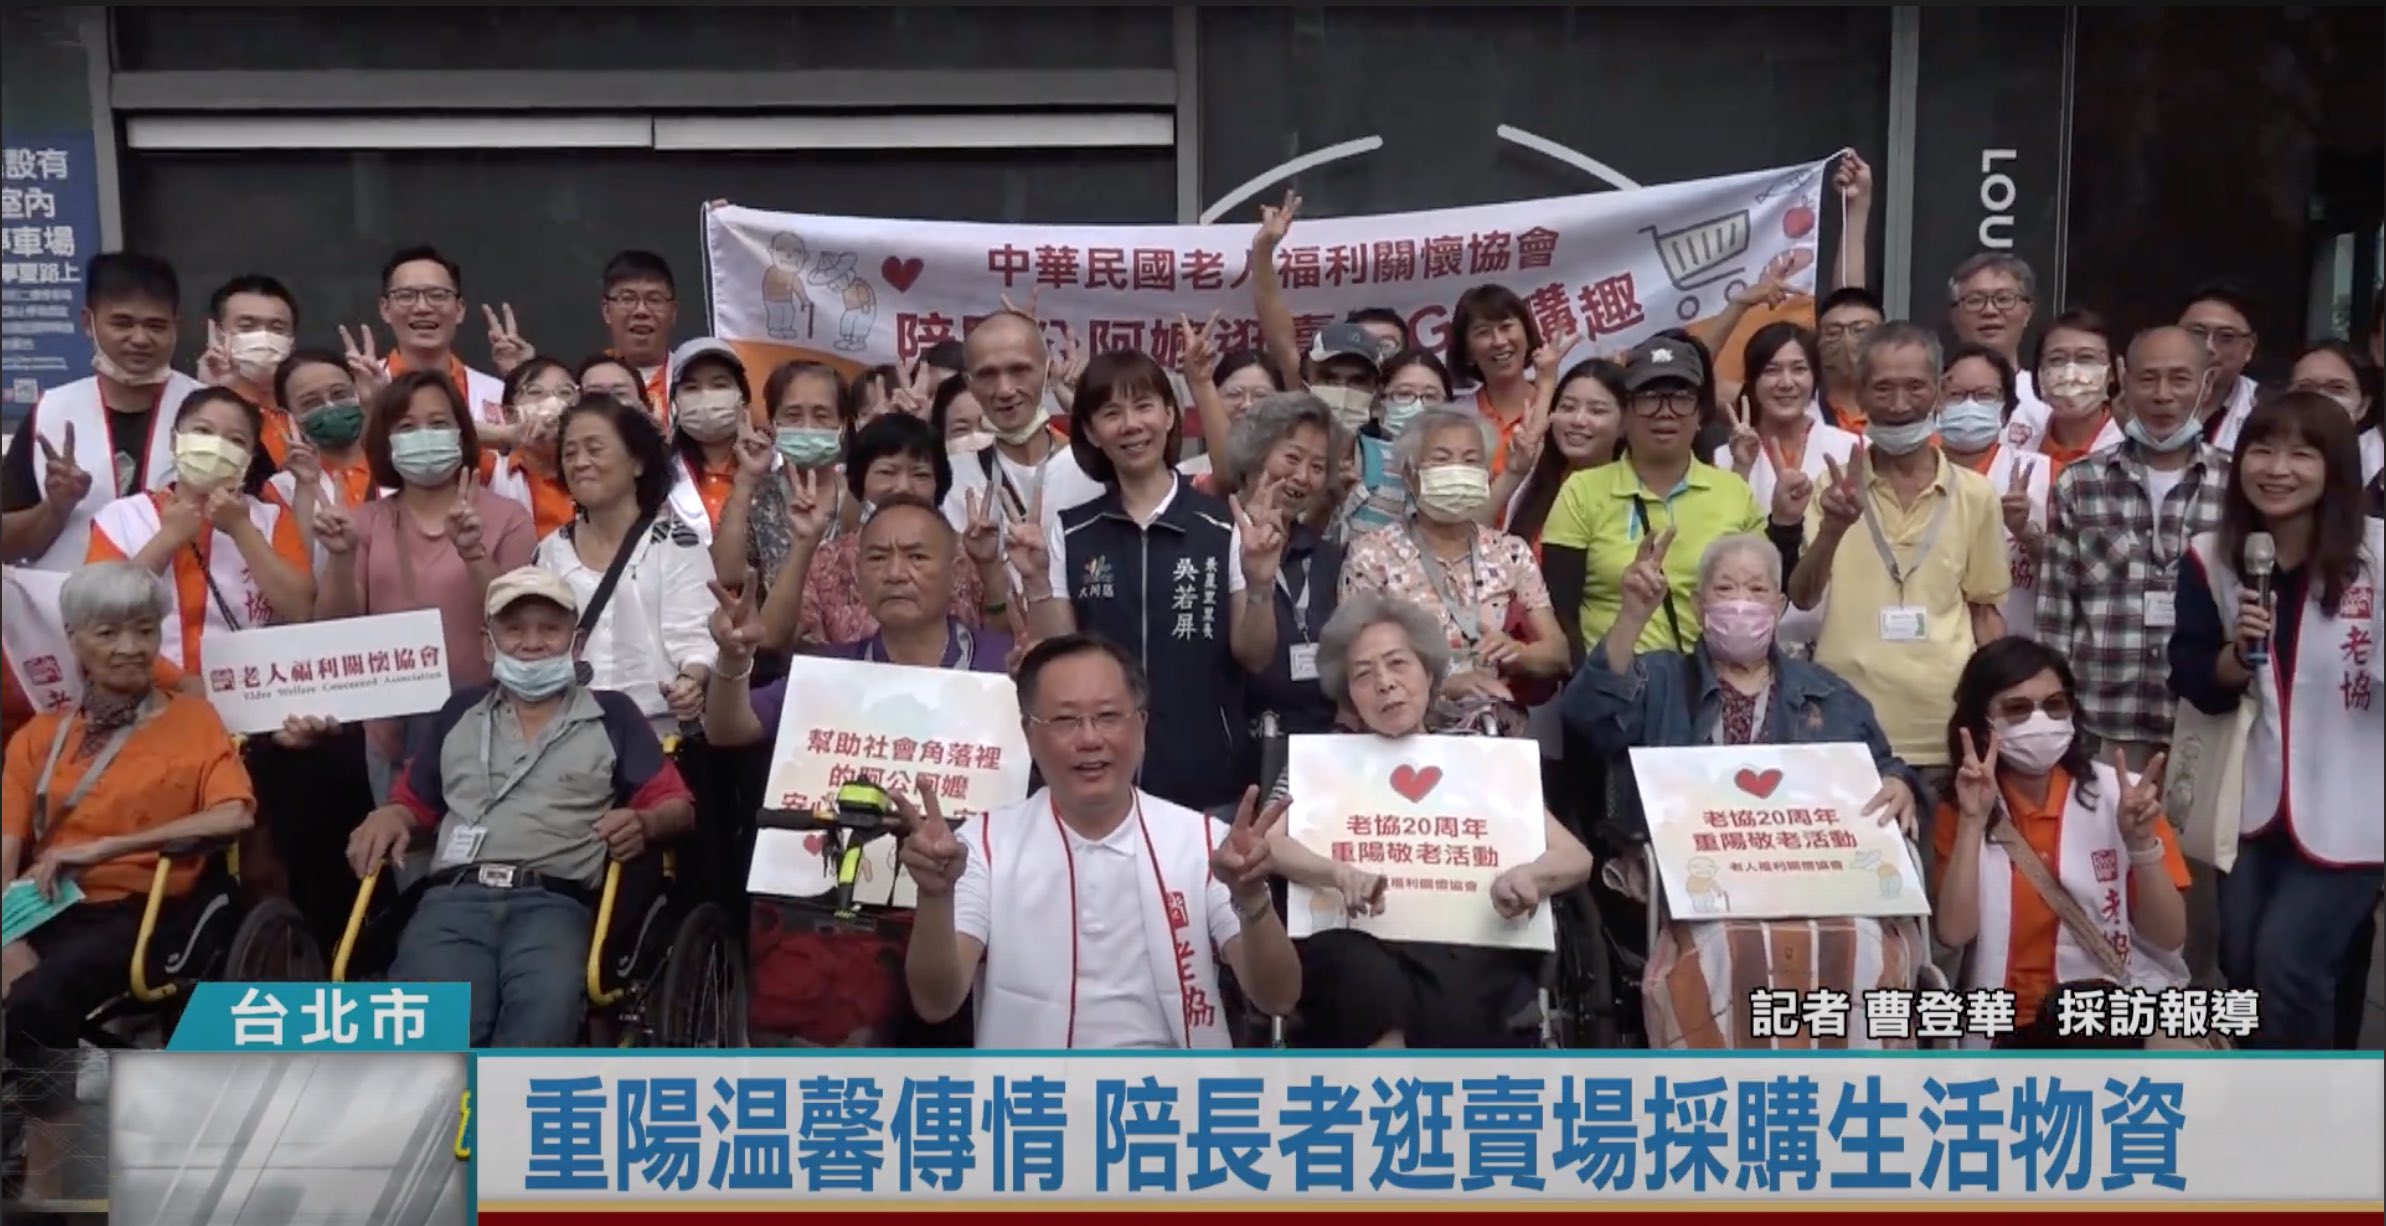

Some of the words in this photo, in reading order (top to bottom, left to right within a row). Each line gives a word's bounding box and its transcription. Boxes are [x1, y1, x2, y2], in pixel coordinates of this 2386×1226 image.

[2, 148, 69, 180] 設有
[241, 645, 440, 688] 老人福利關懷協會
[2340, 625, 2372, 711] 老協
[807, 728, 1002, 771] 幫助社會角落裡
[1346, 814, 1488, 839] 老協20周年
[1703, 808, 1840, 828] 老協20周年
[1331, 841, 1499, 868] 重陽敬老活動
[1693, 829, 1858, 852] 重陽敬老活動
